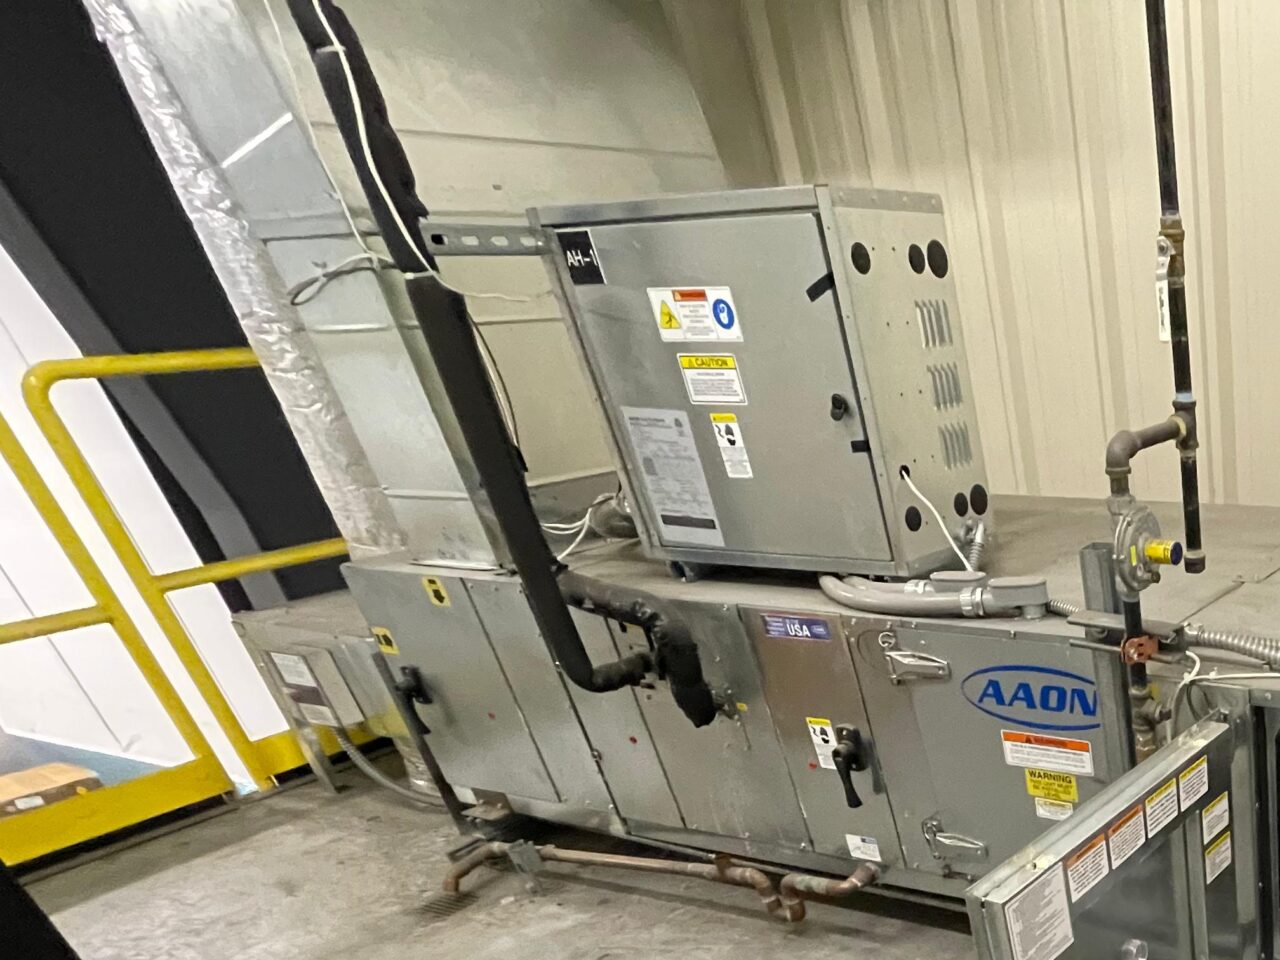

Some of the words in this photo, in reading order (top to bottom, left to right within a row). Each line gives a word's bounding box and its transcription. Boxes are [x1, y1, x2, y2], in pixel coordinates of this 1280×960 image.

[567, 249, 597, 267] AH-1
[694, 358, 728, 367] CAUTION
[787, 623, 811, 637] USA
[978, 679, 1098, 717] AAON
[1028, 770, 1072, 784] WARNING
